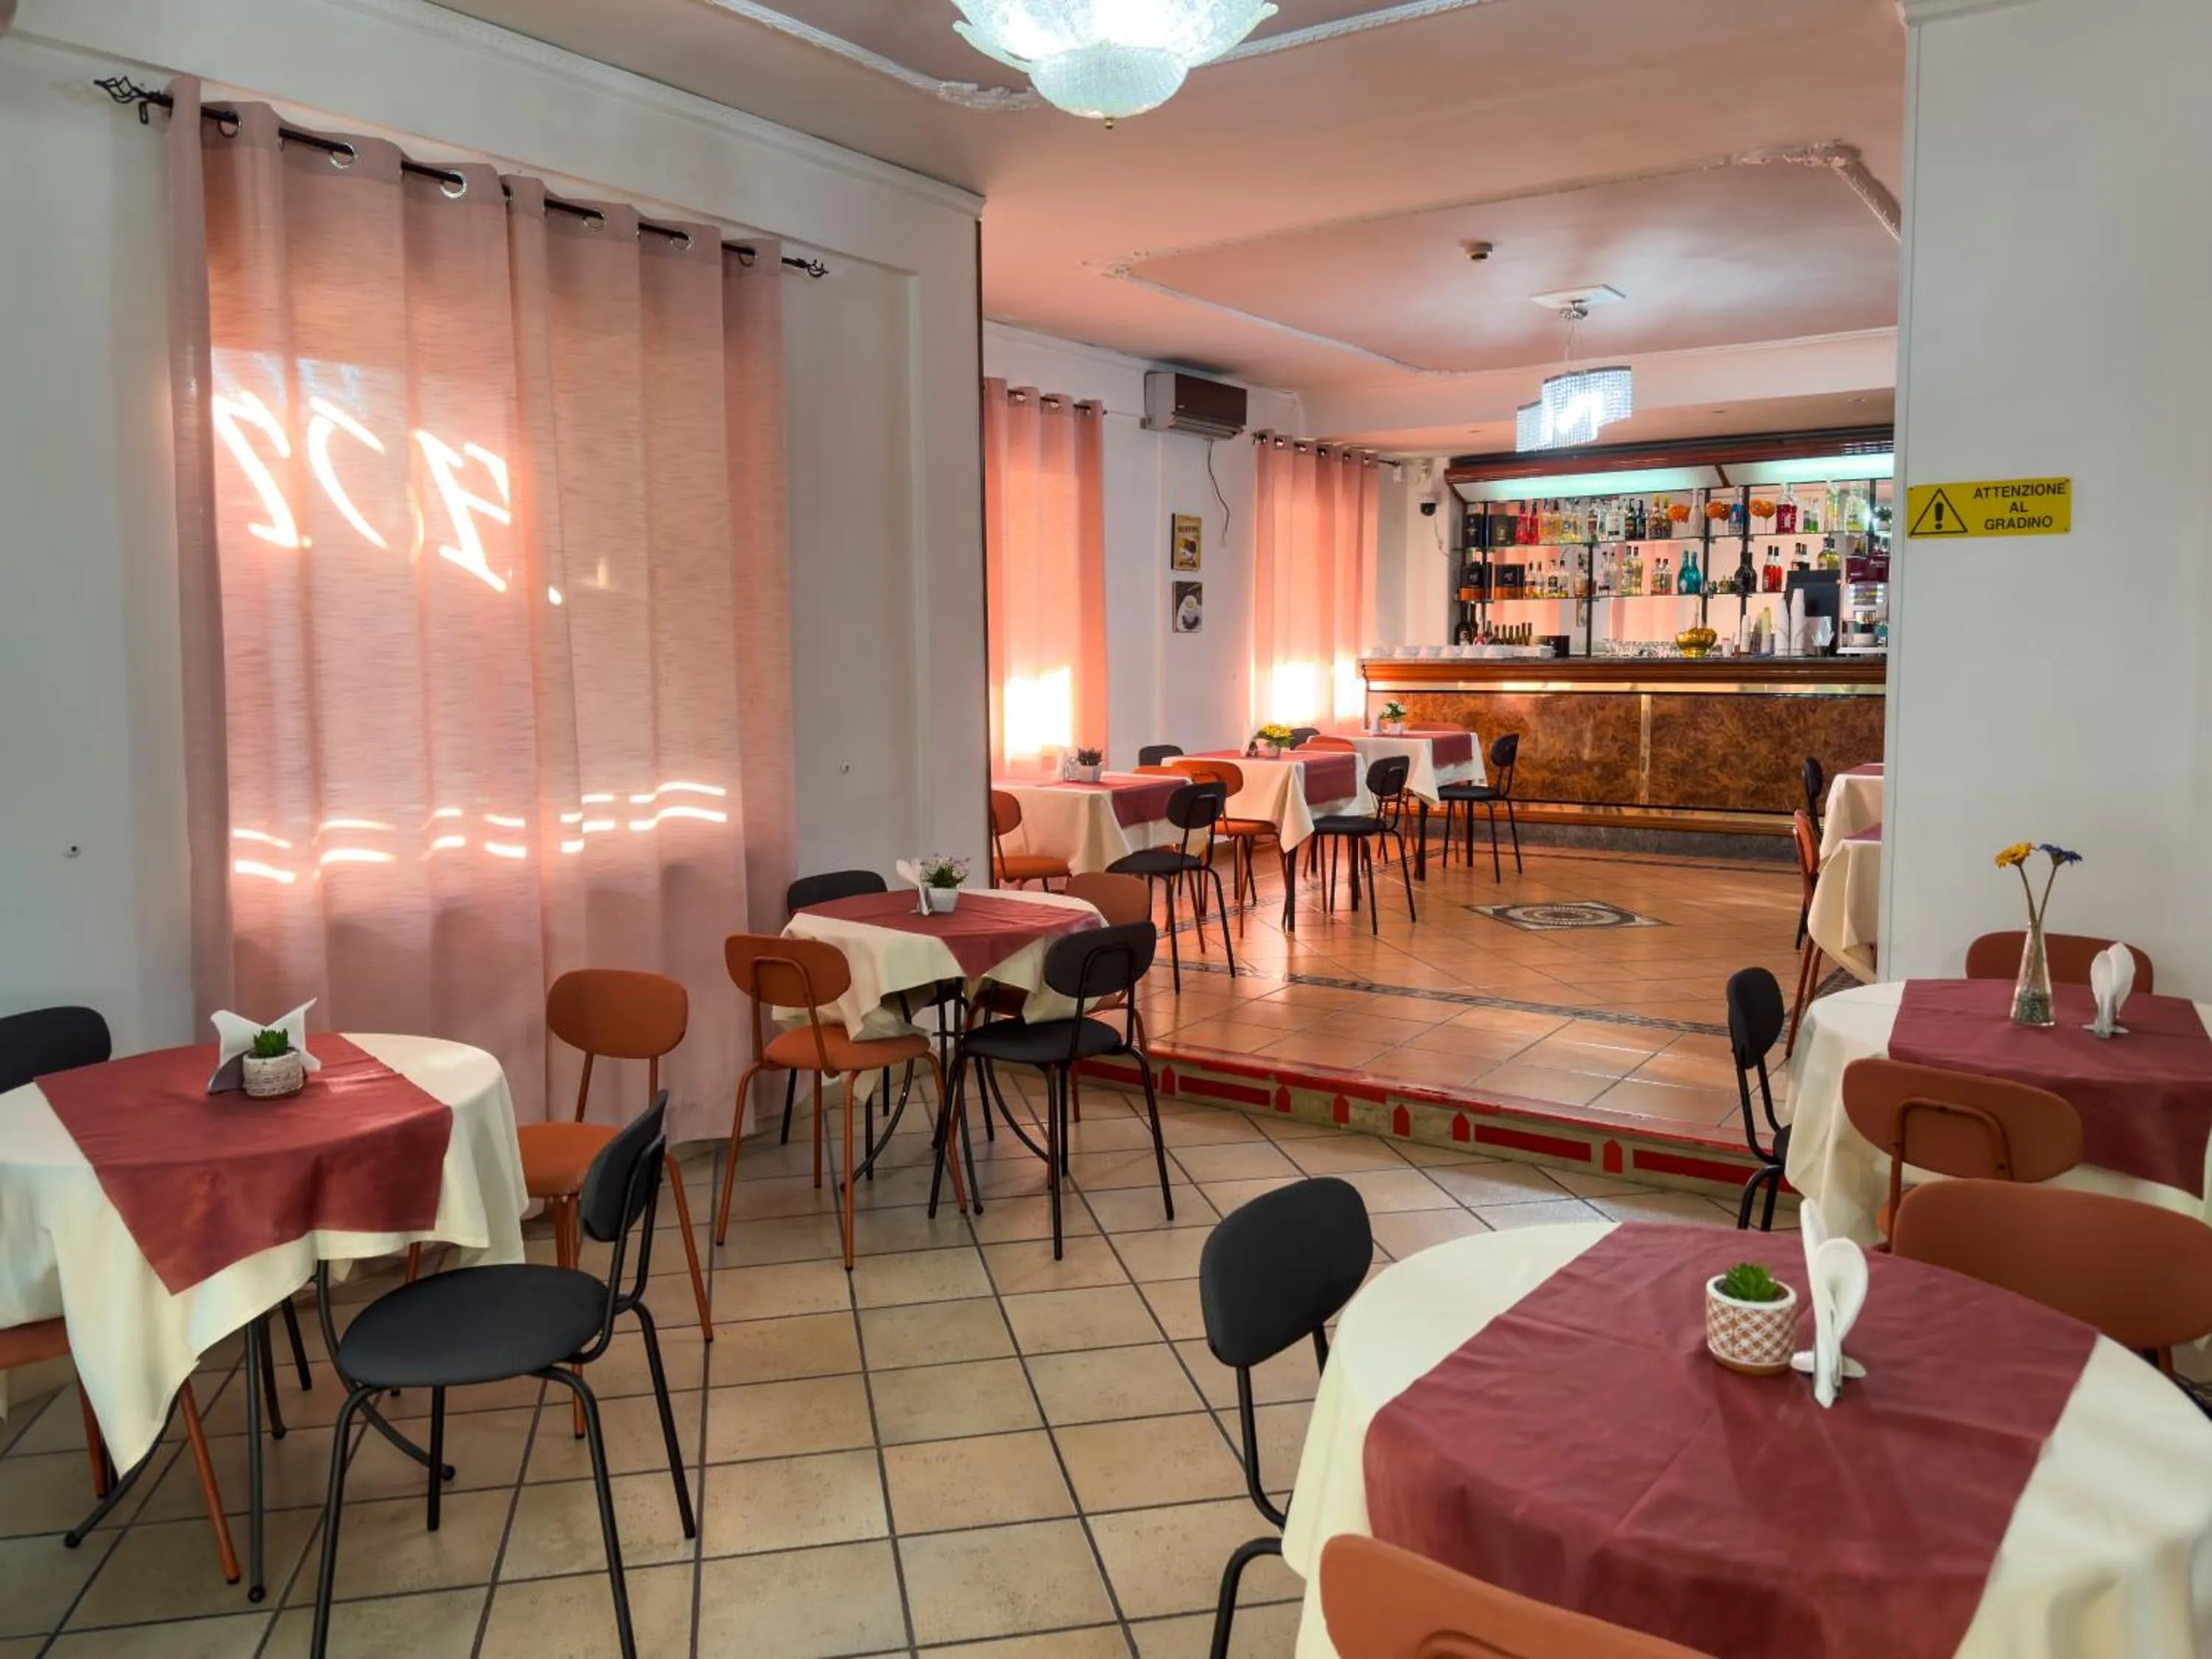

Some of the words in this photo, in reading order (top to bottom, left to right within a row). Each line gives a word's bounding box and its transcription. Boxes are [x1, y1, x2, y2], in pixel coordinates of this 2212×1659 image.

[1973, 483, 2066, 499] ATTENZIONE
[2009, 501, 2028, 513] AL
[1983, 515, 2053, 530] GRADINO
